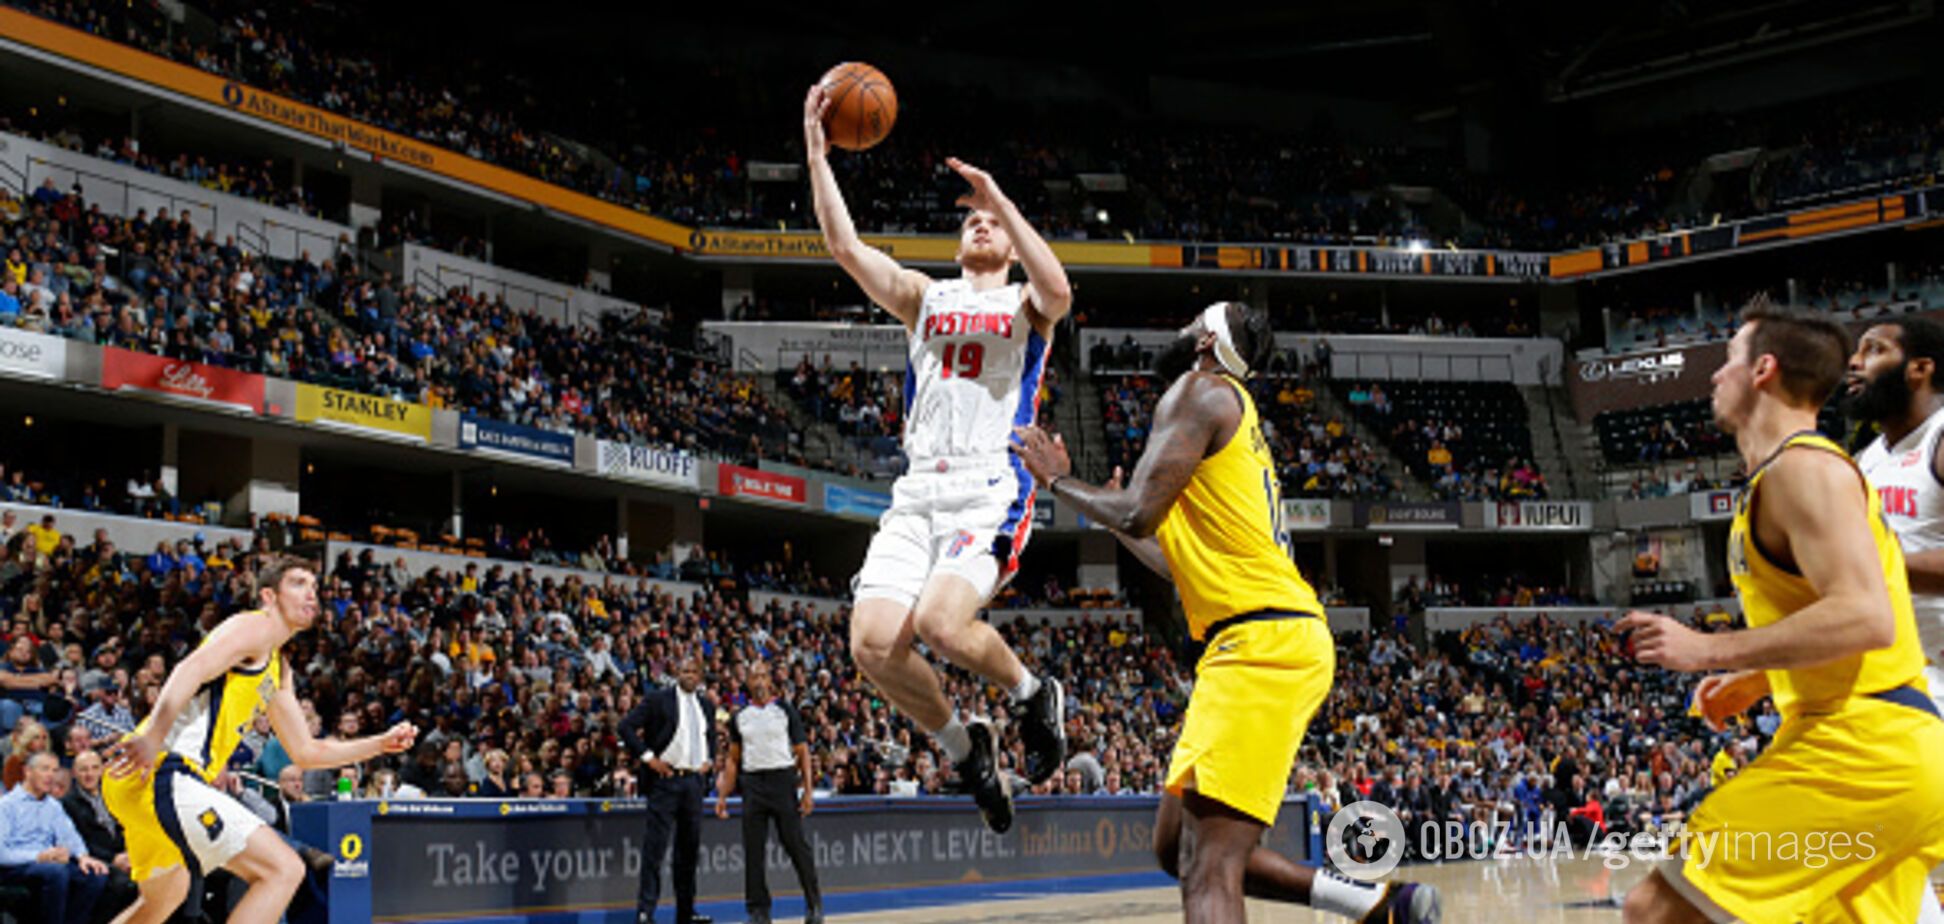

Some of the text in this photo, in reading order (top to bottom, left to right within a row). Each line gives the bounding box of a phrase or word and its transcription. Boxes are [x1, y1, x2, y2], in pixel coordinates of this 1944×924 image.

[247, 94, 435, 165] AStateThatWorks.com
[924, 311, 1014, 342] PISTONS
[941, 341, 985, 380] 19
[161, 361, 215, 398] Lilly
[322, 389, 409, 421] STANLEY
[629, 445, 694, 477] RUOFF
[1522, 503, 1581, 526] IUPUI
[426, 841, 520, 886] Take
[532, 846, 613, 892] your
[813, 831, 845, 867] he
[852, 831, 925, 865] NEXT
[931, 827, 1016, 860] LEVEL.
[1021, 824, 1092, 856] Indiana
